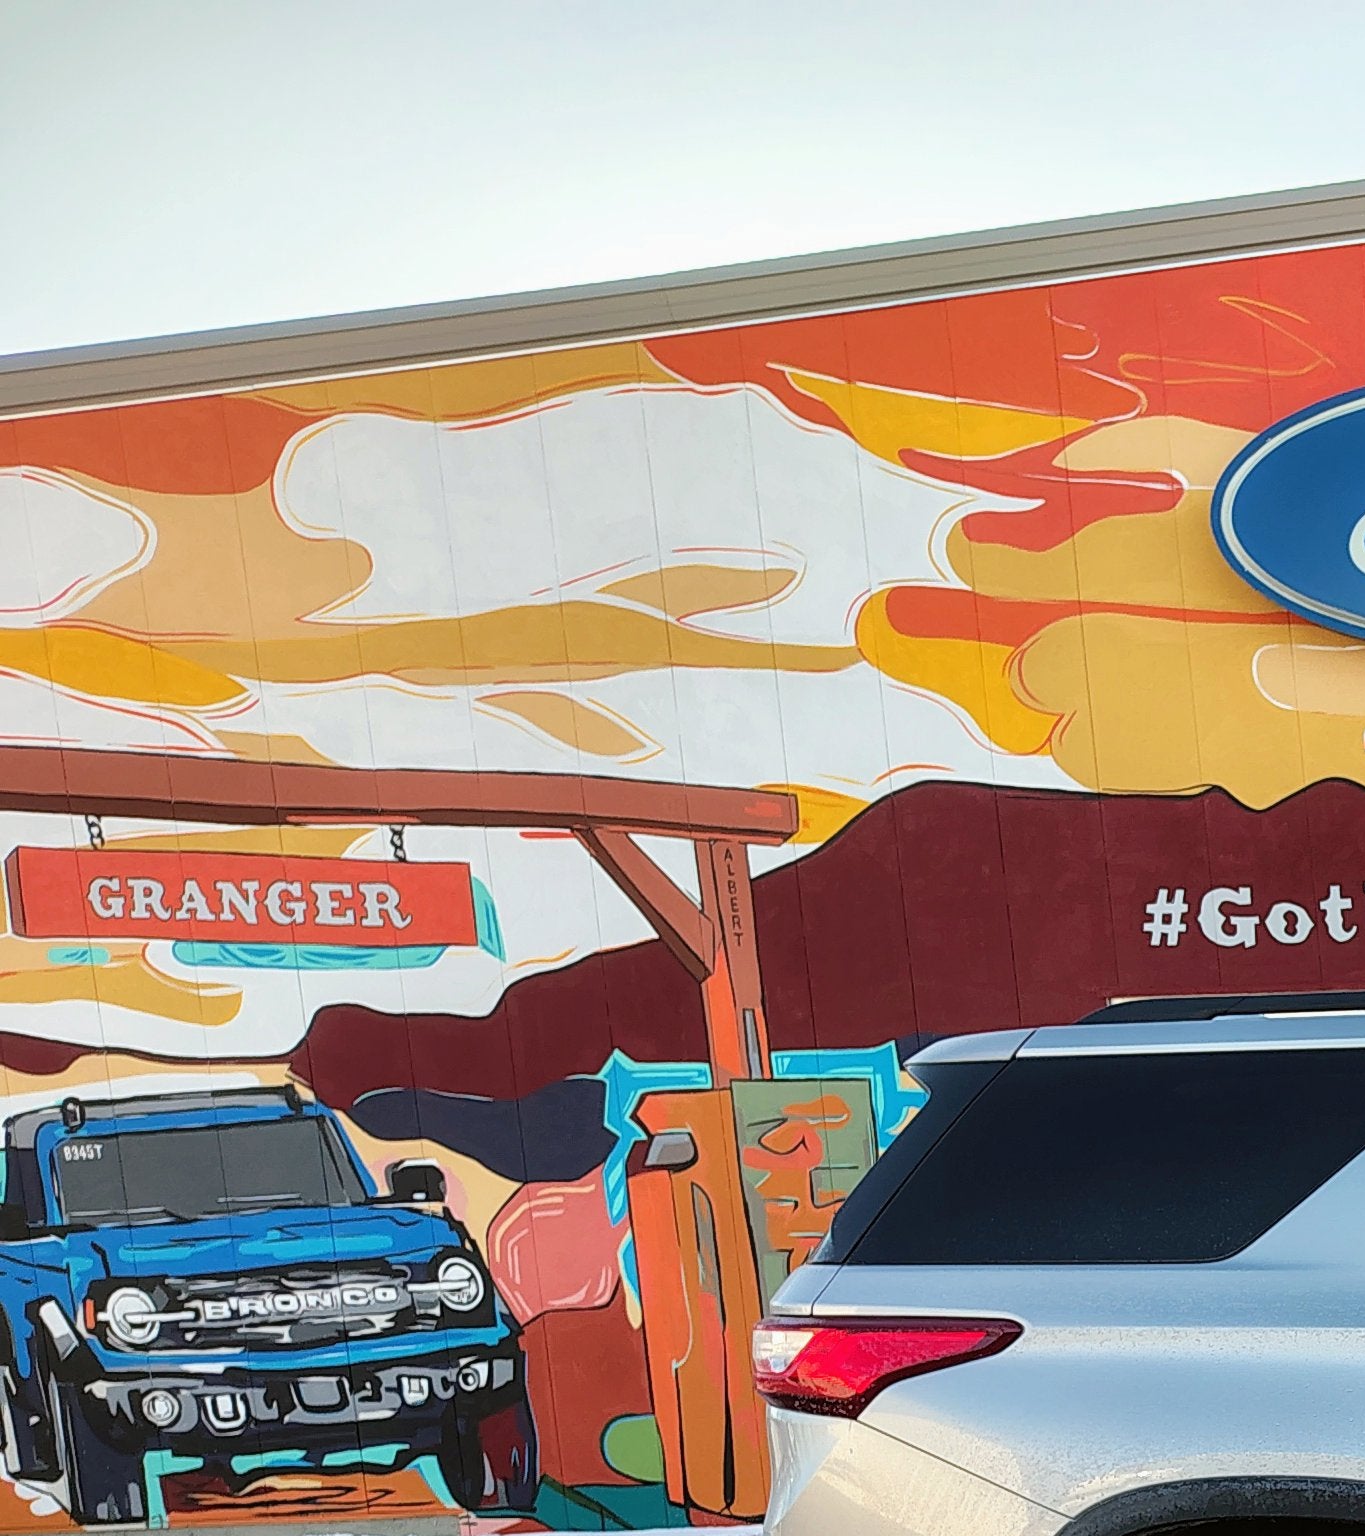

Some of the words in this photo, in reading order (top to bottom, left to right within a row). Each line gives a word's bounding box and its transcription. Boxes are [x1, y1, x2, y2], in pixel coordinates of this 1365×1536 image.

[86, 877, 413, 930] GRANGER
[724, 848, 744, 947] ALBERT
[204, 1287, 398, 1321] BRONCO
